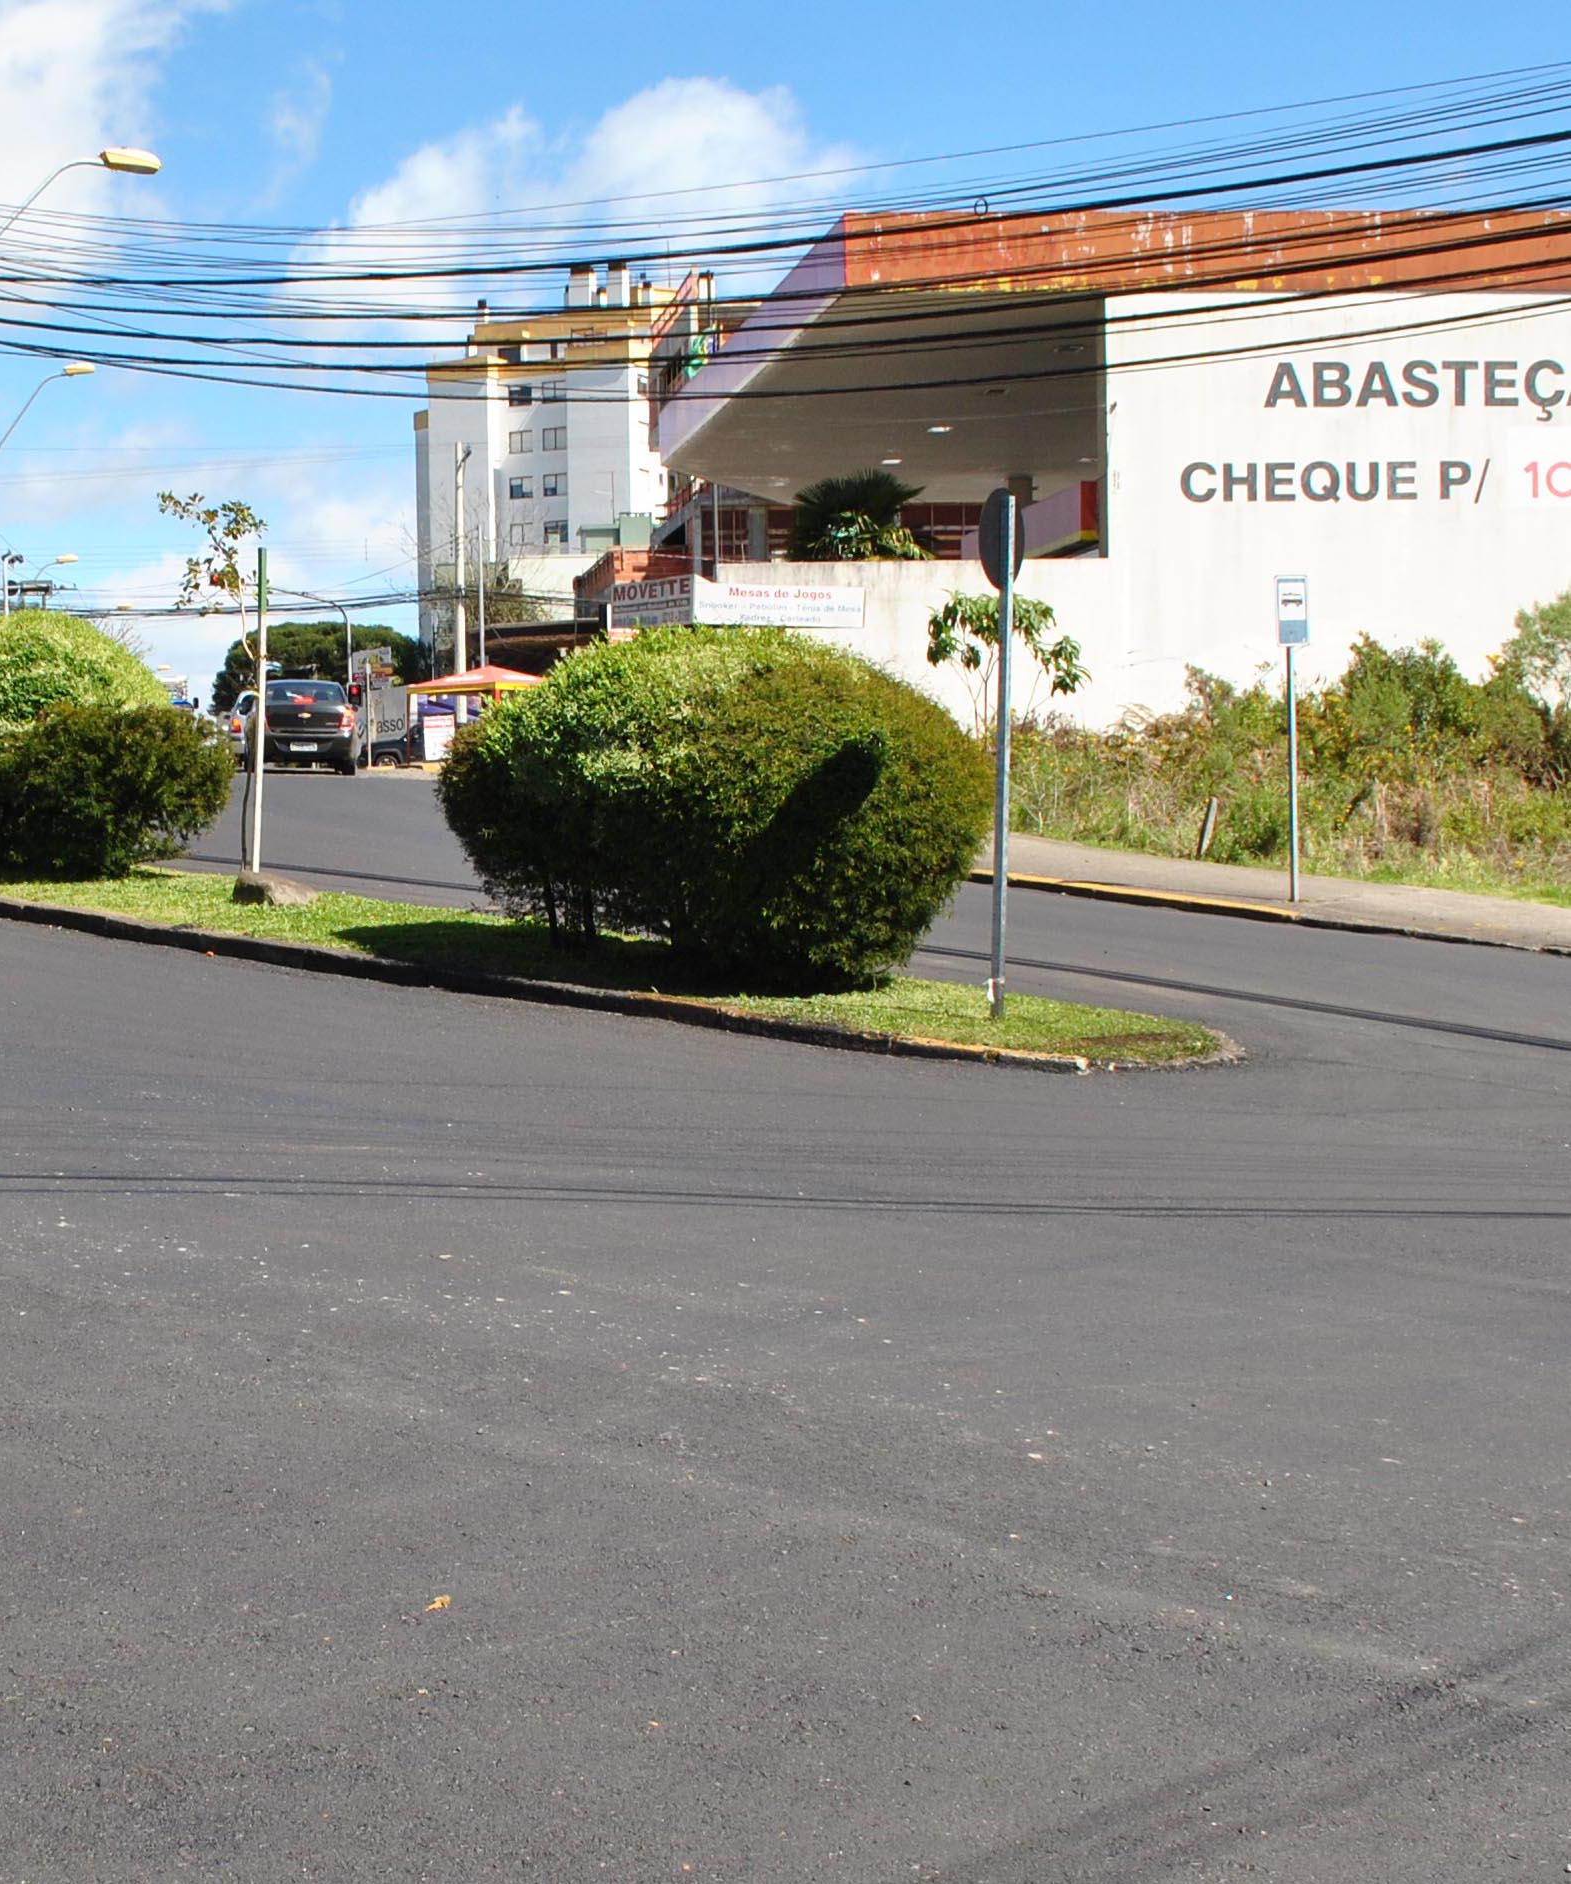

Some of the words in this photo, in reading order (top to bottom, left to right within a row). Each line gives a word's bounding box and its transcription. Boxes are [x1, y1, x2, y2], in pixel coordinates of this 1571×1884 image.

[1263, 359, 1571, 422] ABASTEÇ
[1180, 461, 1418, 503] CHEQUE
[1439, 458, 1490, 504] P/
[613, 578, 691, 601] MOVETTE
[728, 587, 770, 598] Mesas
[774, 588, 789, 599] de
[794, 589, 832, 601] Jogos
